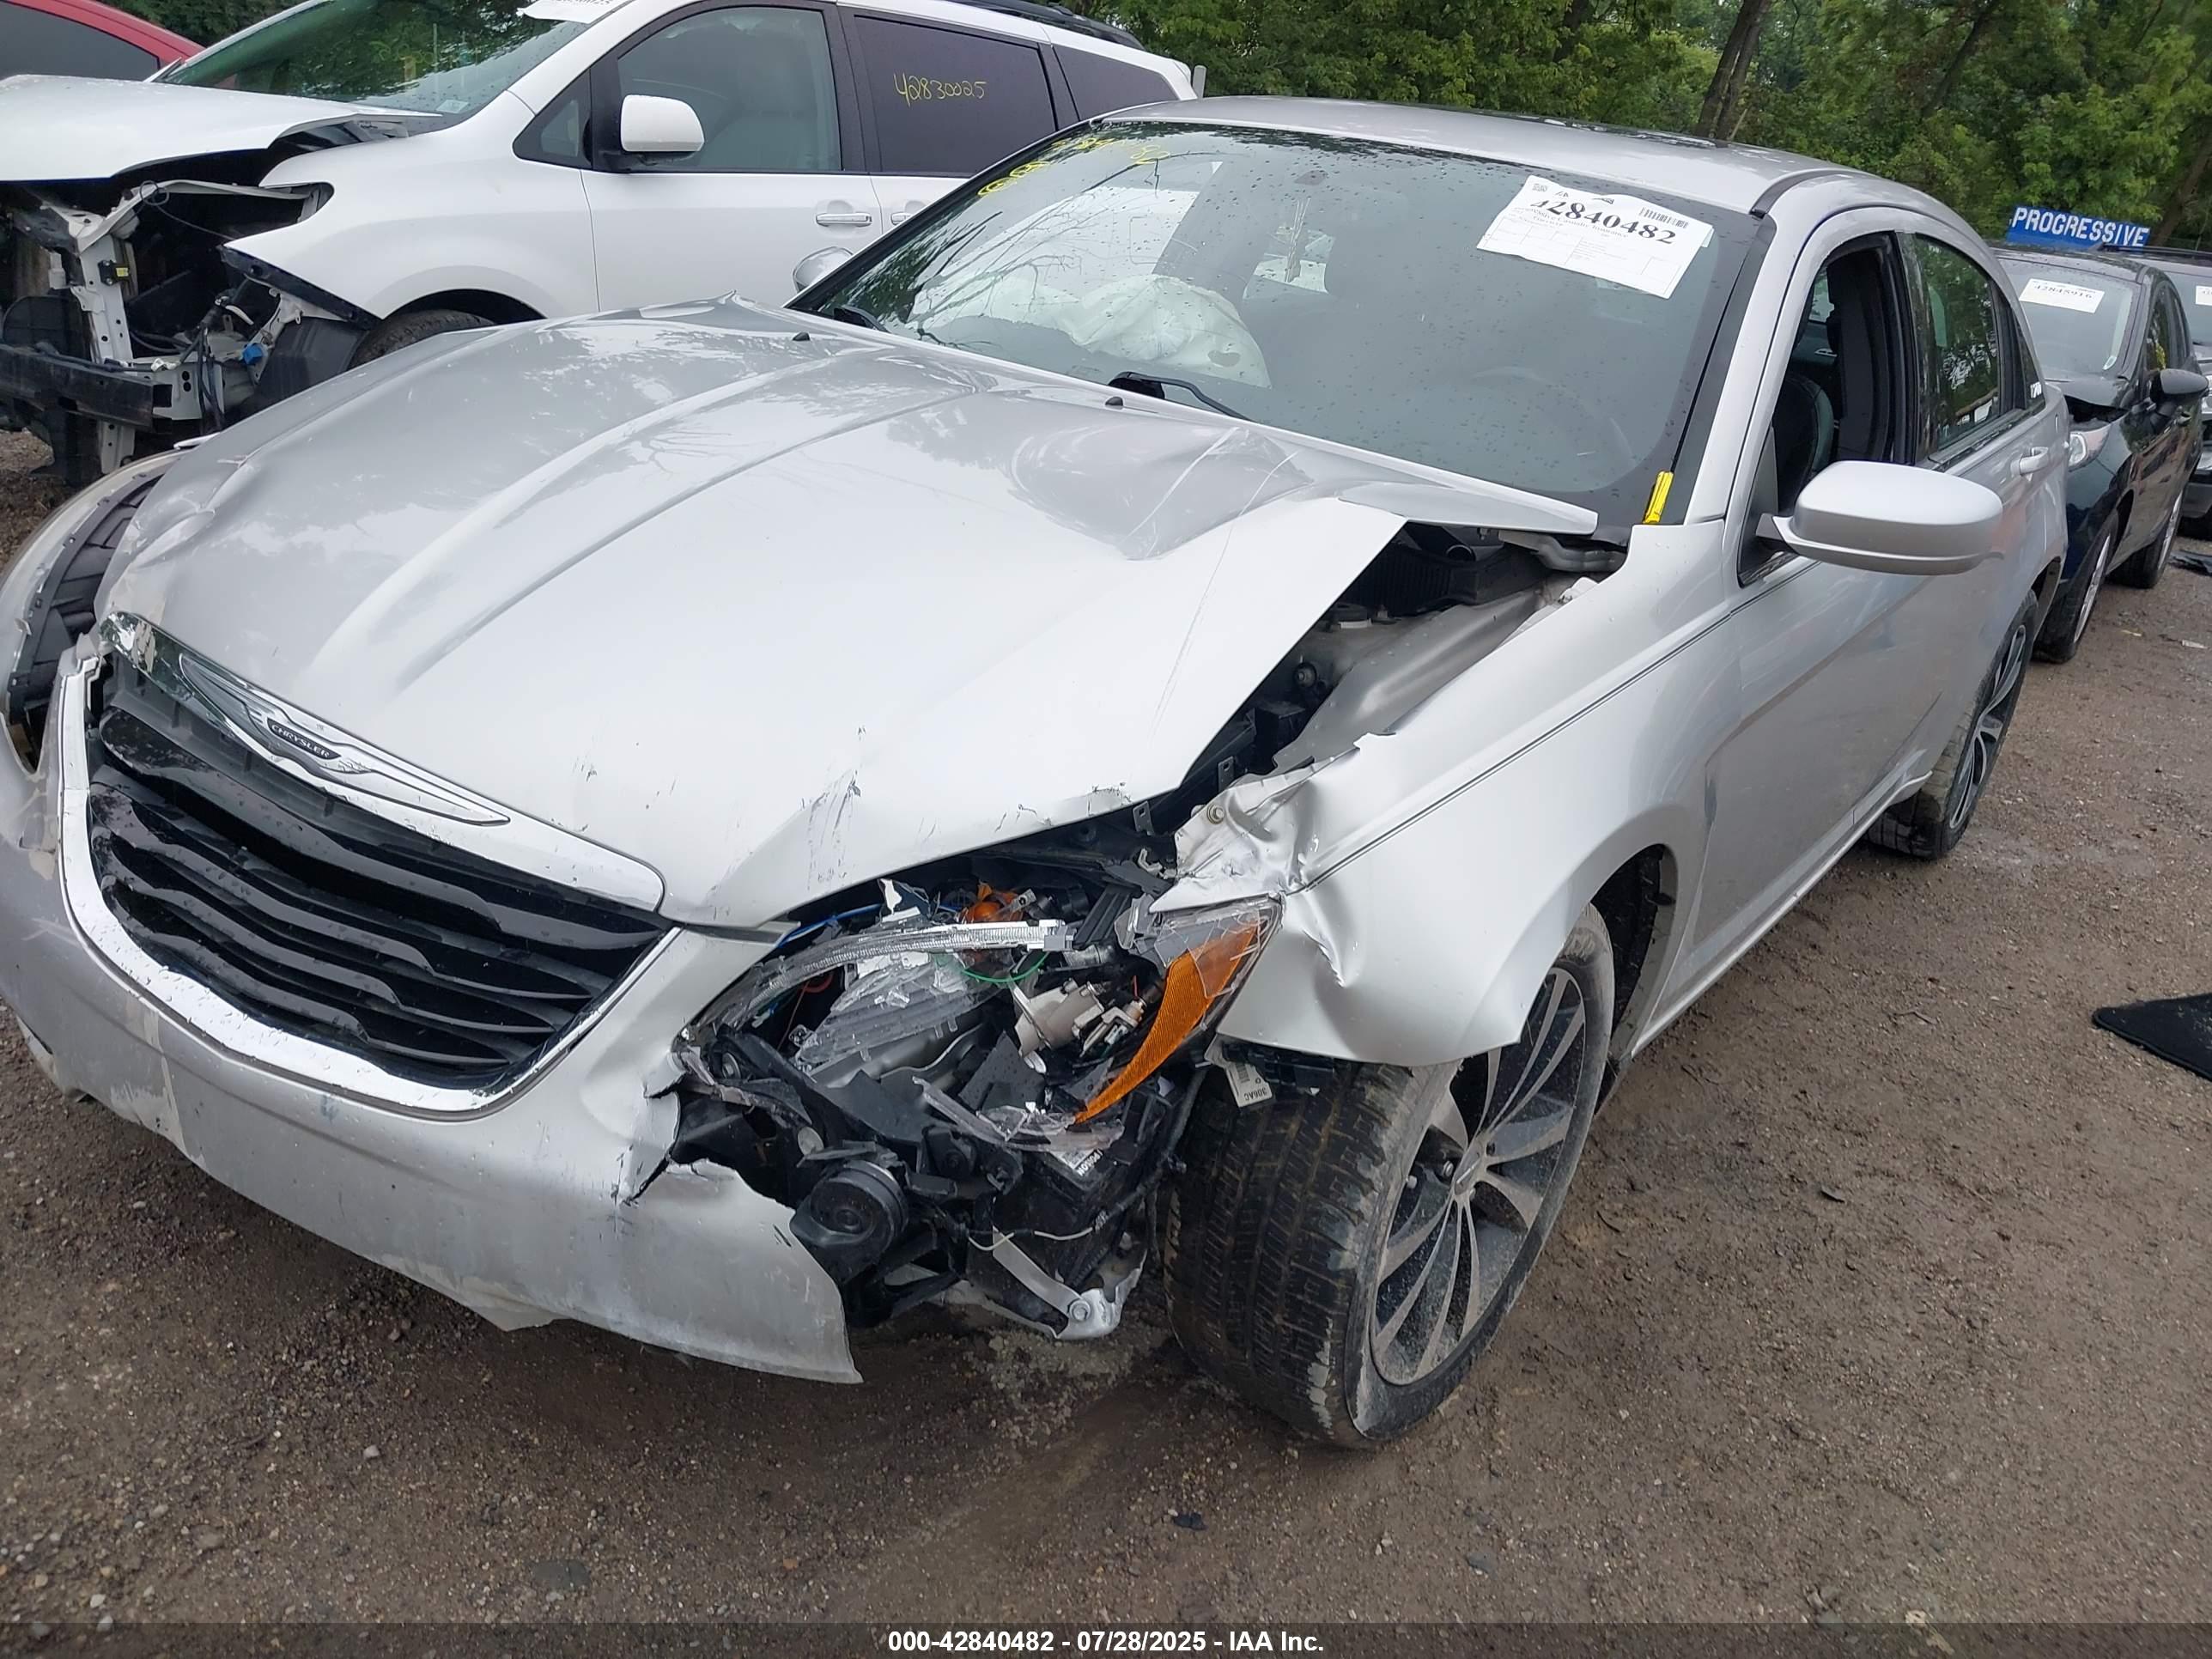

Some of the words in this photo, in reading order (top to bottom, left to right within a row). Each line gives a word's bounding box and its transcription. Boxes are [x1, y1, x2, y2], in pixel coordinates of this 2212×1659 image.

[894, 73, 987, 107] 42830025
[2011, 207, 2151, 247] PROGRESSIVE
[271, 724, 331, 759] CHRYSLER
